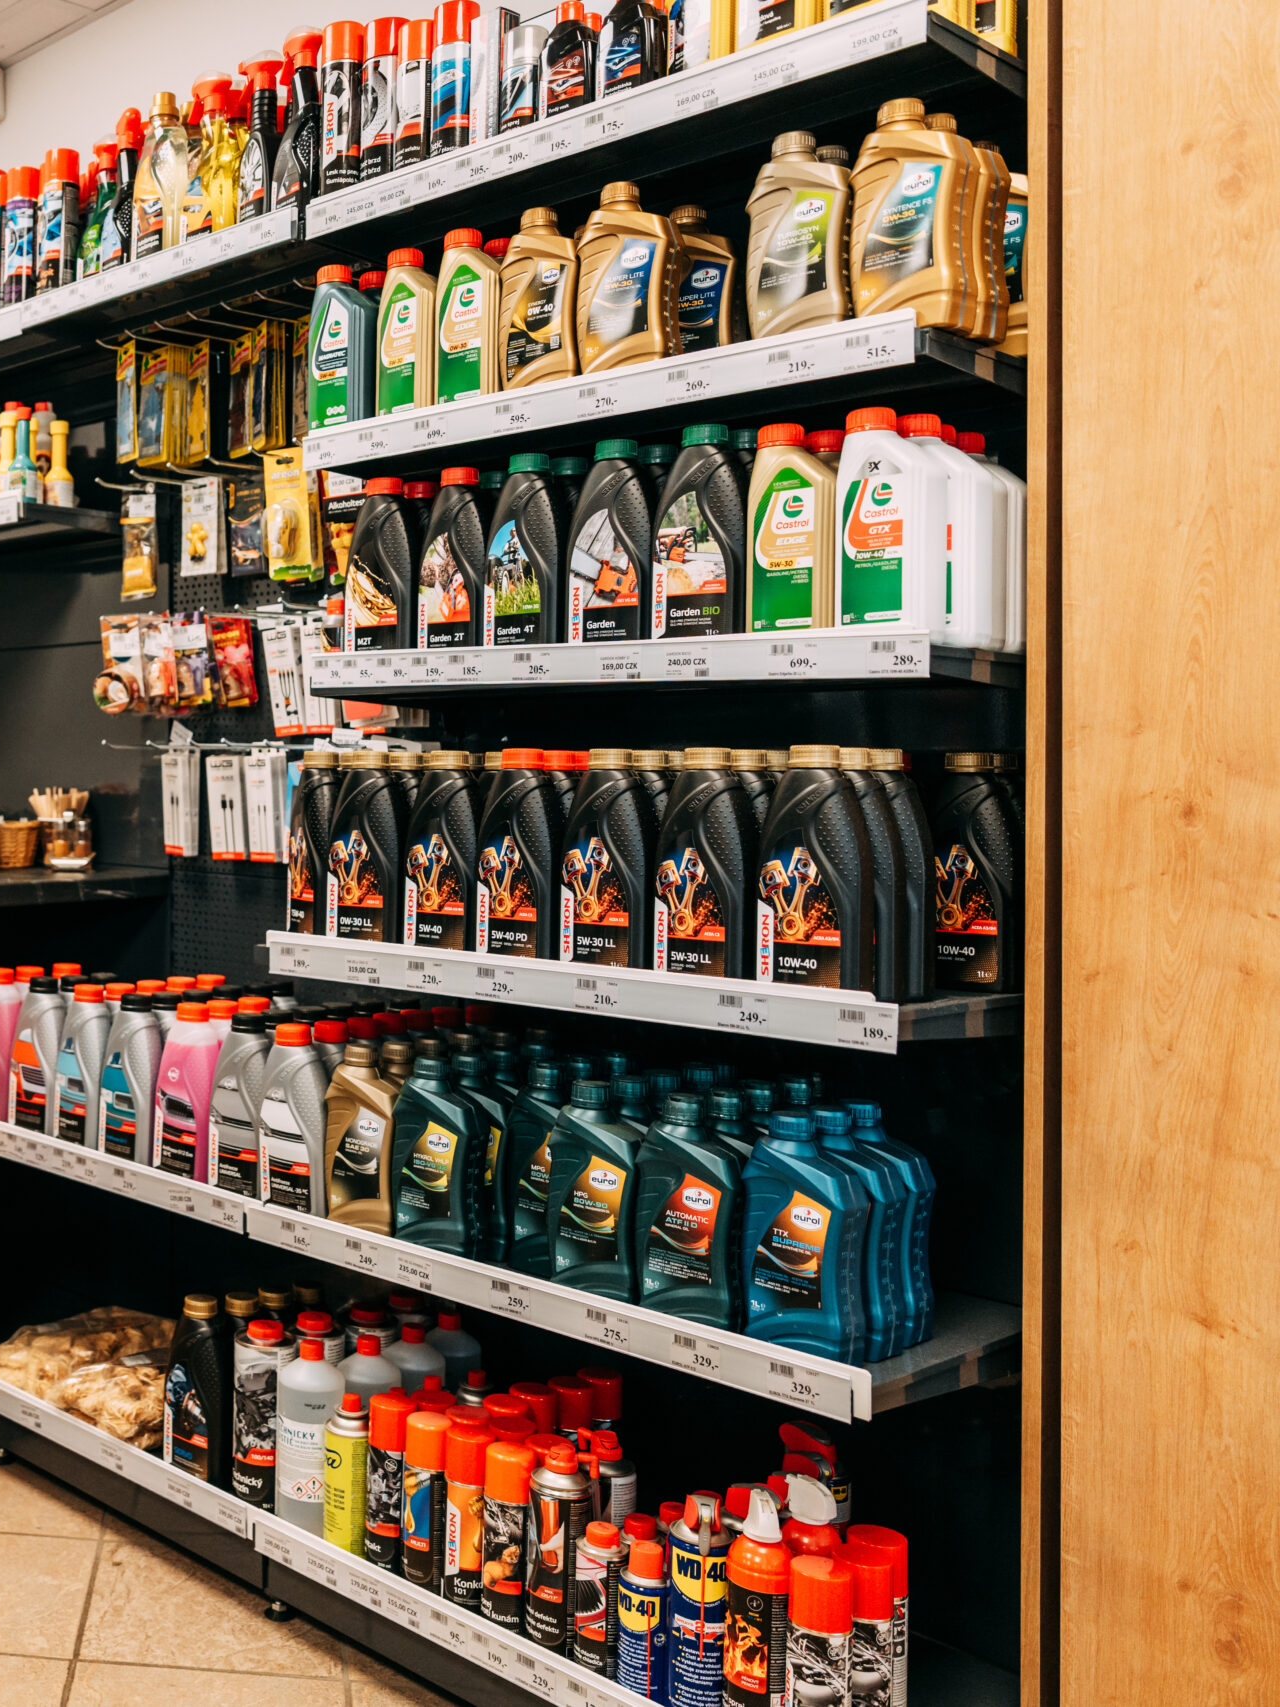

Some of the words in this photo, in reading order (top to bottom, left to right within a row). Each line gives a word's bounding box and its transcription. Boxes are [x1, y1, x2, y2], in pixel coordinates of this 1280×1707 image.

[326, 102, 335, 156] SHERON
[904, 177, 932, 192] eurol
[796, 204, 823, 219] eurol
[776, 225, 820, 240] TURBOSYN
[623, 253, 648, 264] eurol
[629, 271, 644, 279] LITE
[694, 274, 718, 284] eurol
[454, 306, 478, 319] Castrol
[527, 304, 554, 316] 0W-40
[393, 323, 413, 335] Castrol
[324, 338, 346, 349] Castrol
[866, 346, 896, 359] 515,-
[788, 360, 816, 374] 219,-
[686, 380, 710, 392] 269,-
[595, 396, 618, 408] 270,-
[510, 414, 530, 424] 595,-
[427, 429, 446, 440] 699,-
[864, 506, 899, 520] Castrol
[776, 518, 810, 530] Castrol
[868, 524, 892, 535] GTX
[776, 534, 808, 546] EDGE
[856, 550, 884, 560] 10W-40
[769, 560, 794, 568] 5W-30
[655, 573, 664, 630] SHERON
[572, 587, 580, 640] SHERON
[670, 607, 700, 618] Garden
[702, 606, 720, 616] BIO
[497, 626, 520, 636] Garden
[524, 624, 535, 634] 4T
[586, 620, 616, 630] Garden
[358, 636, 372, 646] M2T
[430, 634, 452, 643] Garden
[454, 632, 464, 642] 2T
[602, 664, 624, 672] 169,00
[625, 662, 638, 670] CZK
[668, 658, 691, 667] 240,00
[693, 658, 706, 666] CZK
[790, 656, 818, 669] 699,-
[892, 655, 922, 667] 289,-
[394, 668, 408, 678] 89,-
[426, 667, 444, 678] 159,-
[462, 666, 482, 676] 185,-
[528, 664, 550, 675] 205,-
[340, 917, 362, 926] 0W-30
[364, 918, 372, 927] LL
[418, 924, 442, 934] 5W-40
[492, 930, 514, 941] 5W-40
[516, 932, 528, 942] PD
[577, 936, 603, 947] 5W-30
[605, 938, 616, 948] LL
[761, 914, 770, 976] SHERON
[938, 945, 975, 956] 10W-40
[293, 959, 310, 968] 189,-
[670, 951, 698, 962] 5W-30
[700, 953, 712, 964] LL
[778, 956, 818, 969] 10W-40
[348, 966, 366, 974] 319,00
[367, 966, 377, 974] CZK
[422, 974, 442, 985] 220,-
[492, 982, 514, 994] 229,-
[594, 994, 618, 1006] 210,-
[739, 1012, 766, 1025] 249,-
[862, 1026, 892, 1040] 189,-
[359, 1124, 379, 1134] eurol
[360, 1146, 370, 1154] 30
[428, 1140, 450, 1150] eurol
[531, 1164, 546, 1173] MPG
[592, 1176, 617, 1186] eurol
[574, 1190, 588, 1199] HPG
[685, 1195, 712, 1206] eurol
[574, 1196, 608, 1209] 80W-90
[666, 1210, 709, 1224] AUTOMATIC
[666, 1216, 682, 1224] ATF
[794, 1214, 821, 1226] eurol
[772, 1228, 788, 1238] TTX
[772, 1235, 820, 1252] SUPREME
[359, 1254, 378, 1268] 249,-
[399, 1264, 418, 1276] 235,00
[418, 1271, 430, 1280] CZK
[508, 1296, 530, 1310] 259,-
[604, 1328, 628, 1344] 275,-
[692, 1354, 719, 1370] 329,-
[791, 1382, 820, 1399] 329,-
[410, 1539, 427, 1548] MULTI
[350, 1579, 368, 1592] 179,00
[369, 1587, 379, 1597] CZK
[454, 1586, 467, 1596] 101
[406, 1607, 418, 1618] CZK
[492, 1612, 520, 1624] kunám
[535, 1611, 558, 1624] defektu
[537, 1621, 560, 1634] defektu
[450, 1631, 465, 1646] 95,-
[488, 1652, 507, 1670] 199,-
[532, 1674, 554, 1692] 229,-
